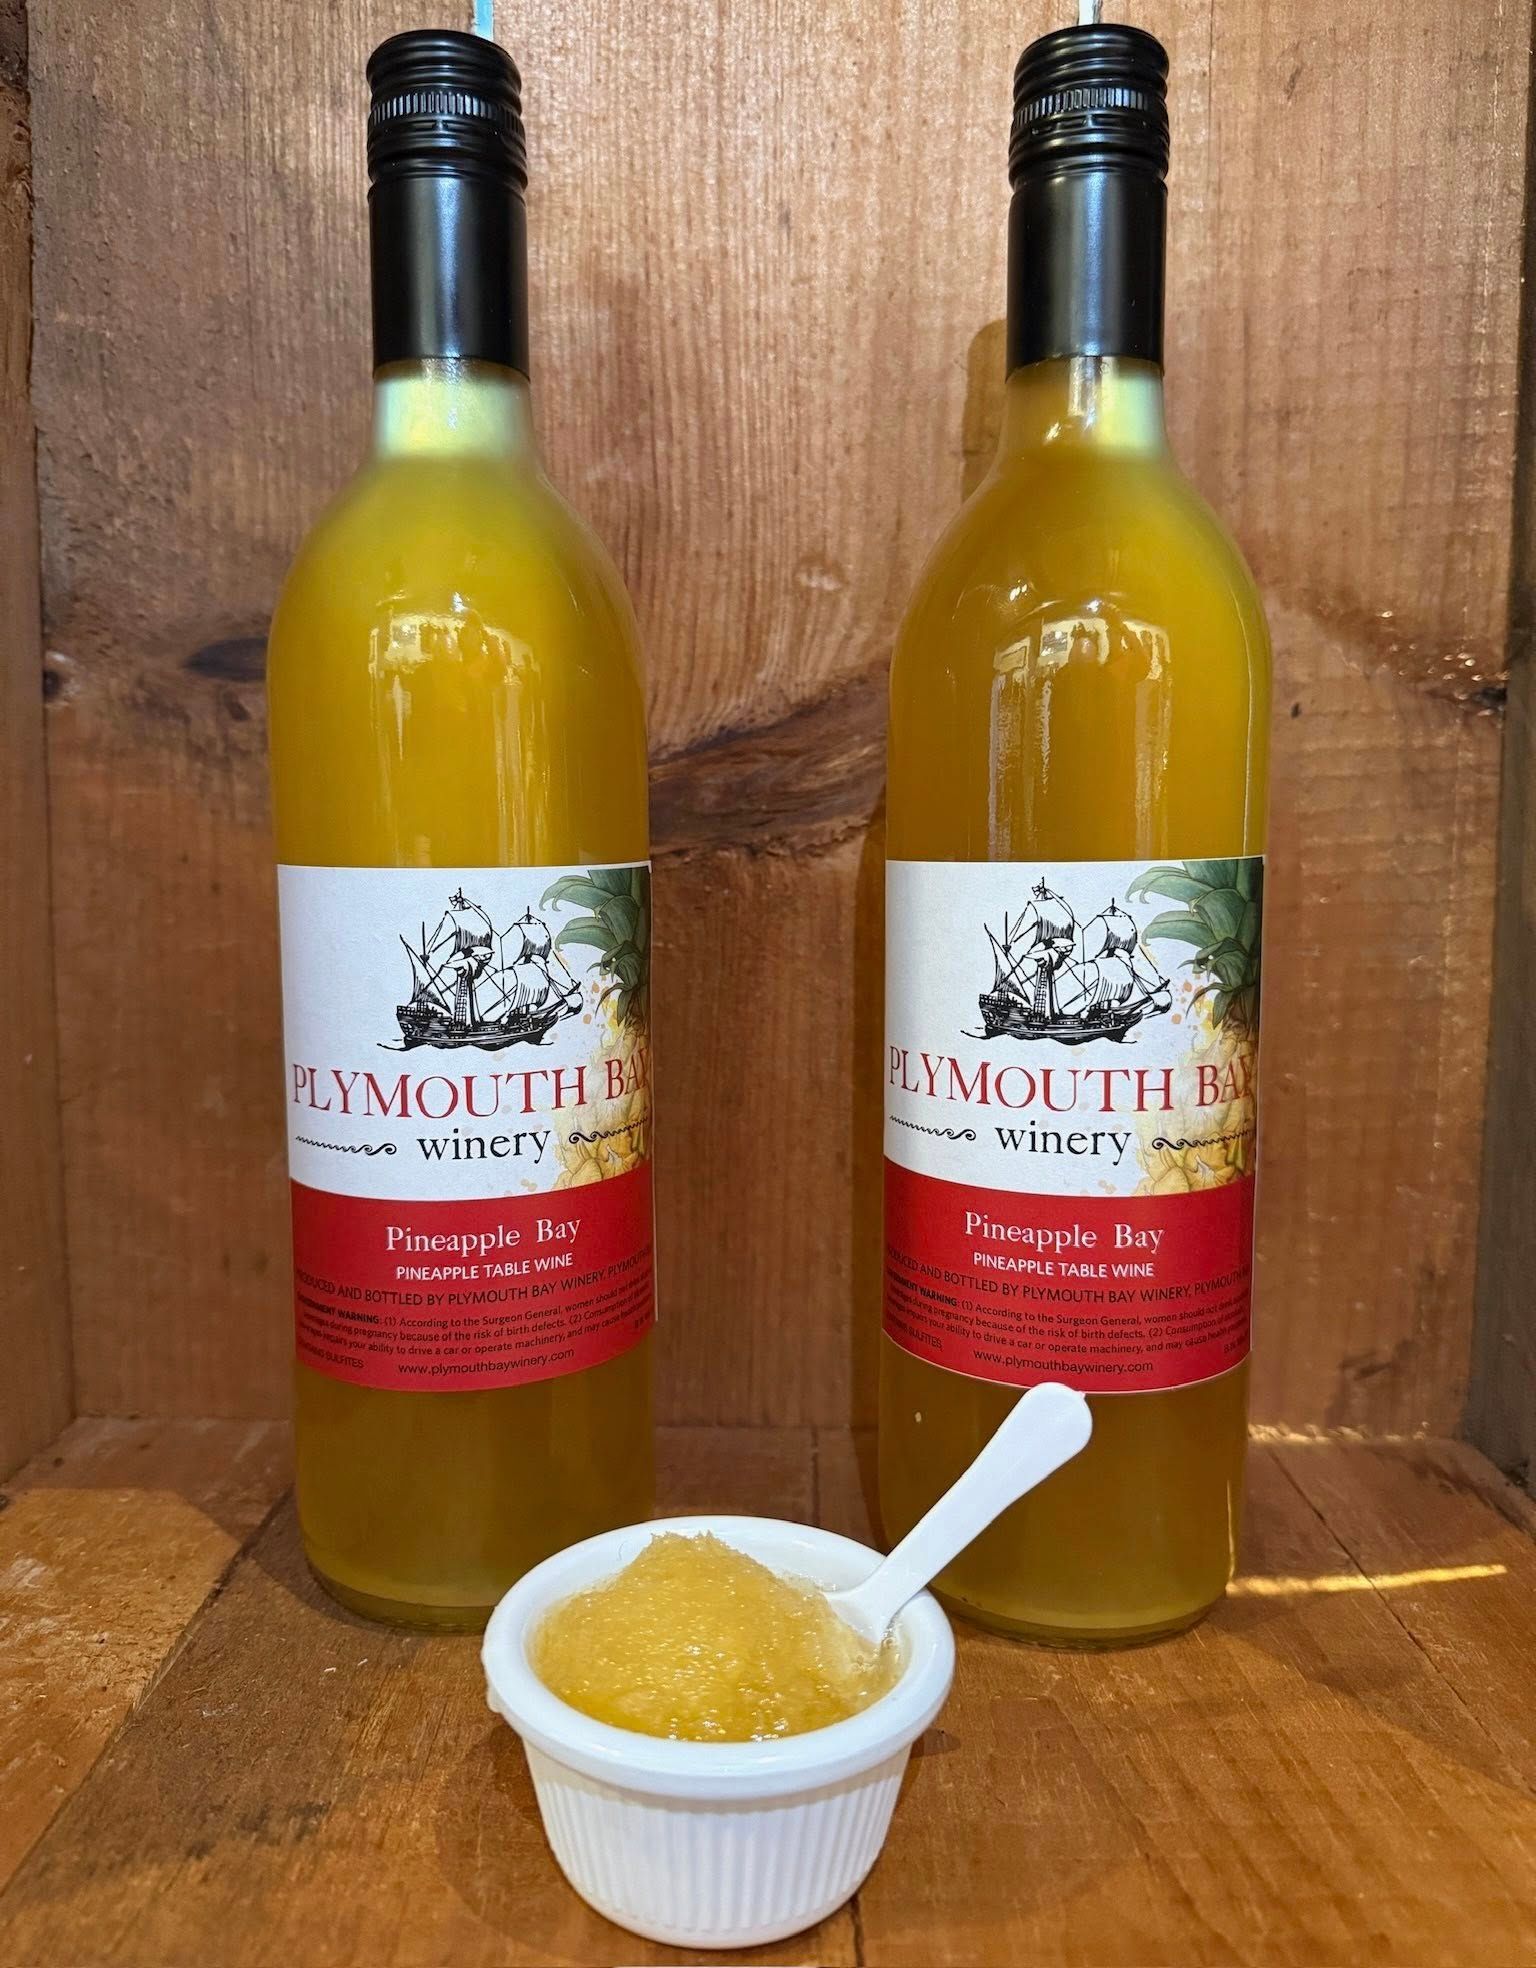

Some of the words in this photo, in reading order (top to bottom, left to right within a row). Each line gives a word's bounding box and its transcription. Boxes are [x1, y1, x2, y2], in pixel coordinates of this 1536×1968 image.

[293, 1063, 588, 1119] PLYMOUTH
[889, 1045, 1175, 1112] PLYMOUTH
[417, 1128, 551, 1164] winery
[995, 1120, 1132, 1165] winery
[385, 1225, 520, 1258] Pineapple
[536, 1218, 582, 1244] Bay
[965, 1211, 1097, 1254] Pineapple
[1114, 1223, 1164, 1255] Bay
[396, 1265, 479, 1281] PINEAPPLE
[483, 1259, 531, 1278] TABLE
[534, 1253, 574, 1273] WINE
[973, 1251, 1055, 1276] PINEAPPLE
[1058, 1262, 1108, 1278] TABLE
[1111, 1262, 1154, 1278] WINE
[297, 1268, 336, 1295] ODUCED
[338, 1284, 362, 1300] AND
[365, 1289, 423, 1306] BOTTLED
[427, 1293, 445, 1306] BY
[448, 1287, 528, 1305] PLYMOUTH
[532, 1280, 557, 1298] BAY
[919, 1264, 941, 1280] AND
[944, 1271, 998, 1293] BOTTLED
[1002, 1283, 1019, 1297] BY
[1023, 1285, 1104, 1303] PLYMOUTH
[1108, 1289, 1136, 1303] BAY
[1140, 1284, 1191, 1302] WINERY,
[337, 1308, 381, 1324] WARNING:
[384, 1317, 397, 1327] (1)
[400, 1317, 449, 1329] According
[451, 1317, 461, 1327] to
[463, 1316, 480, 1327] the
[482, 1313, 523, 1326] Surgeon
[564, 1299, 594, 1312] women
[595, 1290, 618, 1304] should
[354, 1326, 399, 1341] pregnancy
[400, 1331, 440, 1342] because
[441, 1331, 452, 1342] of
[454, 1330, 471, 1341] the
[473, 1328, 491, 1340] risk
[494, 1326, 504, 1337] of
[506, 1323, 530, 1336] birth
[531, 1319, 566, 1333] defects.
[569, 1313, 582, 1326] (2)
[933, 1305, 974, 1327] pregnancy
[975, 1316, 1015, 1332] because
[1015, 1323, 1027, 1334] of
[1028, 1325, 1045, 1336] the
[1047, 1328, 1066, 1338] risk
[1067, 1328, 1079, 1338] of
[1081, 1328, 1106, 1339] birth
[1107, 1330, 1146, 1340] defects.
[1148, 1326, 1163, 1339] (2)
[961, 1300, 973, 1311] (1)
[975, 1303, 1022, 1322] According
[1024, 1309, 1036, 1320] to
[1037, 1312, 1054, 1323] the
[1056, 1313, 1099, 1326] Surgeon
[1100, 1315, 1141, 1327] General,
[1144, 1313, 1177, 1325] women
[1178, 1308, 1205, 1321] should
[349, 1338, 367, 1350] your
[368, 1342, 394, 1355] ability
[396, 1343, 405, 1354] to
[408, 1345, 433, 1355] drive
[434, 1346, 441, 1355] a
[443, 1347, 459, 1355] car
[461, 1346, 473, 1354] or
[475, 1342, 513, 1356] operate
[515, 1332, 566, 1350] machinery,
[567, 1326, 583, 1339] and
[584, 1321, 600, 1334] may
[928, 1317, 945, 1329] your
[946, 1321, 970, 1339] ability
[972, 1330, 982, 1340] to
[983, 1333, 1008, 1346] drive
[1009, 1338, 1015, 1347] a
[1017, 1340, 1032, 1349] car
[1034, 1341, 1045, 1351] or
[1048, 1343, 1087, 1355] operate
[1089, 1343, 1144, 1355] machinery,
[1145, 1342, 1164, 1352] and
[1165, 1340, 1183, 1353] may
[1185, 1336, 1207, 1348] cause
[325, 1351, 364, 1369] SULFITES
[398, 1348, 575, 1376] www.plymouthbaywinery.com
[973, 1350, 1154, 1375] www.plymouthbaywinery.com
